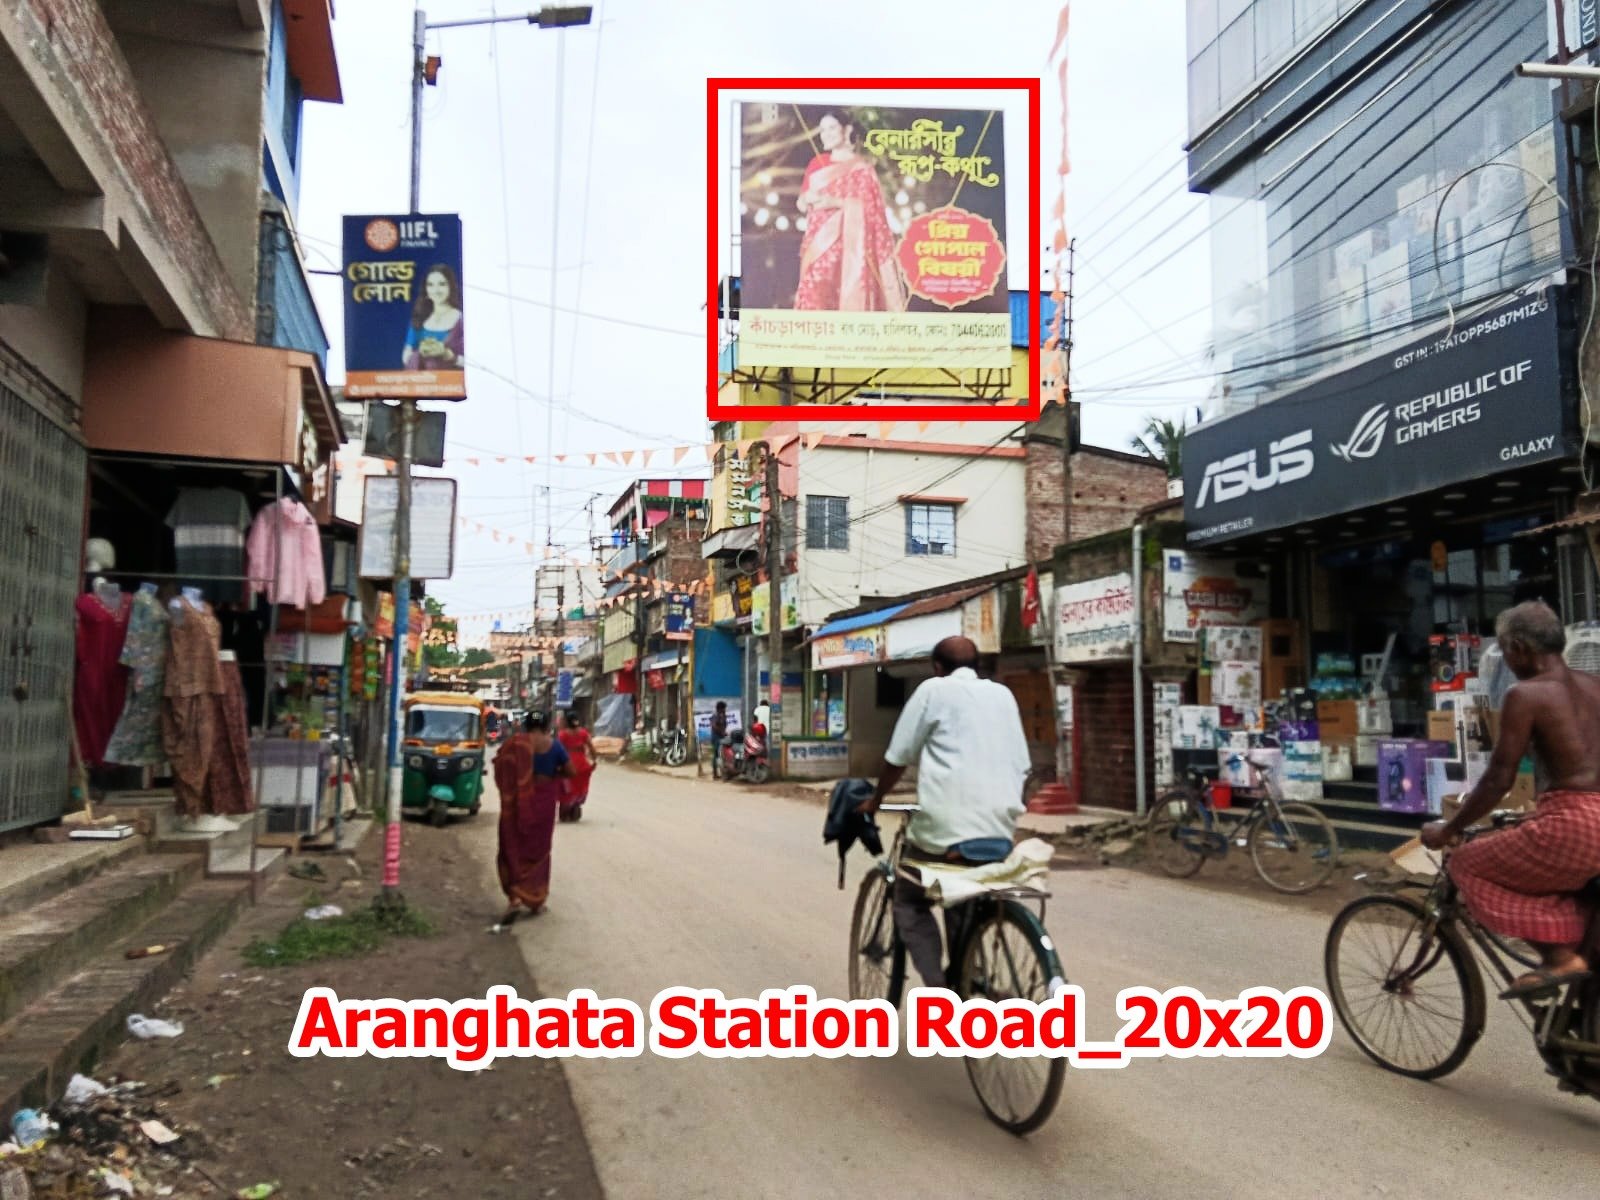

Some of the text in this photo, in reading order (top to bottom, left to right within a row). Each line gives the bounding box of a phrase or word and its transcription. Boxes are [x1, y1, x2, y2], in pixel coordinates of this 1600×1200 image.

[399, 220, 439, 241] IIFL
[914, 240, 989, 257] গোপাল
[347, 261, 416, 282] গোল্ড
[352, 282, 412, 303] লোন
[1394, 359, 1533, 423] REPUBLIC OF
[1395, 402, 1481, 445] GAMERS
[1499, 435, 1556, 461] GALAXY
[1195, 428, 1315, 509] ASUS
